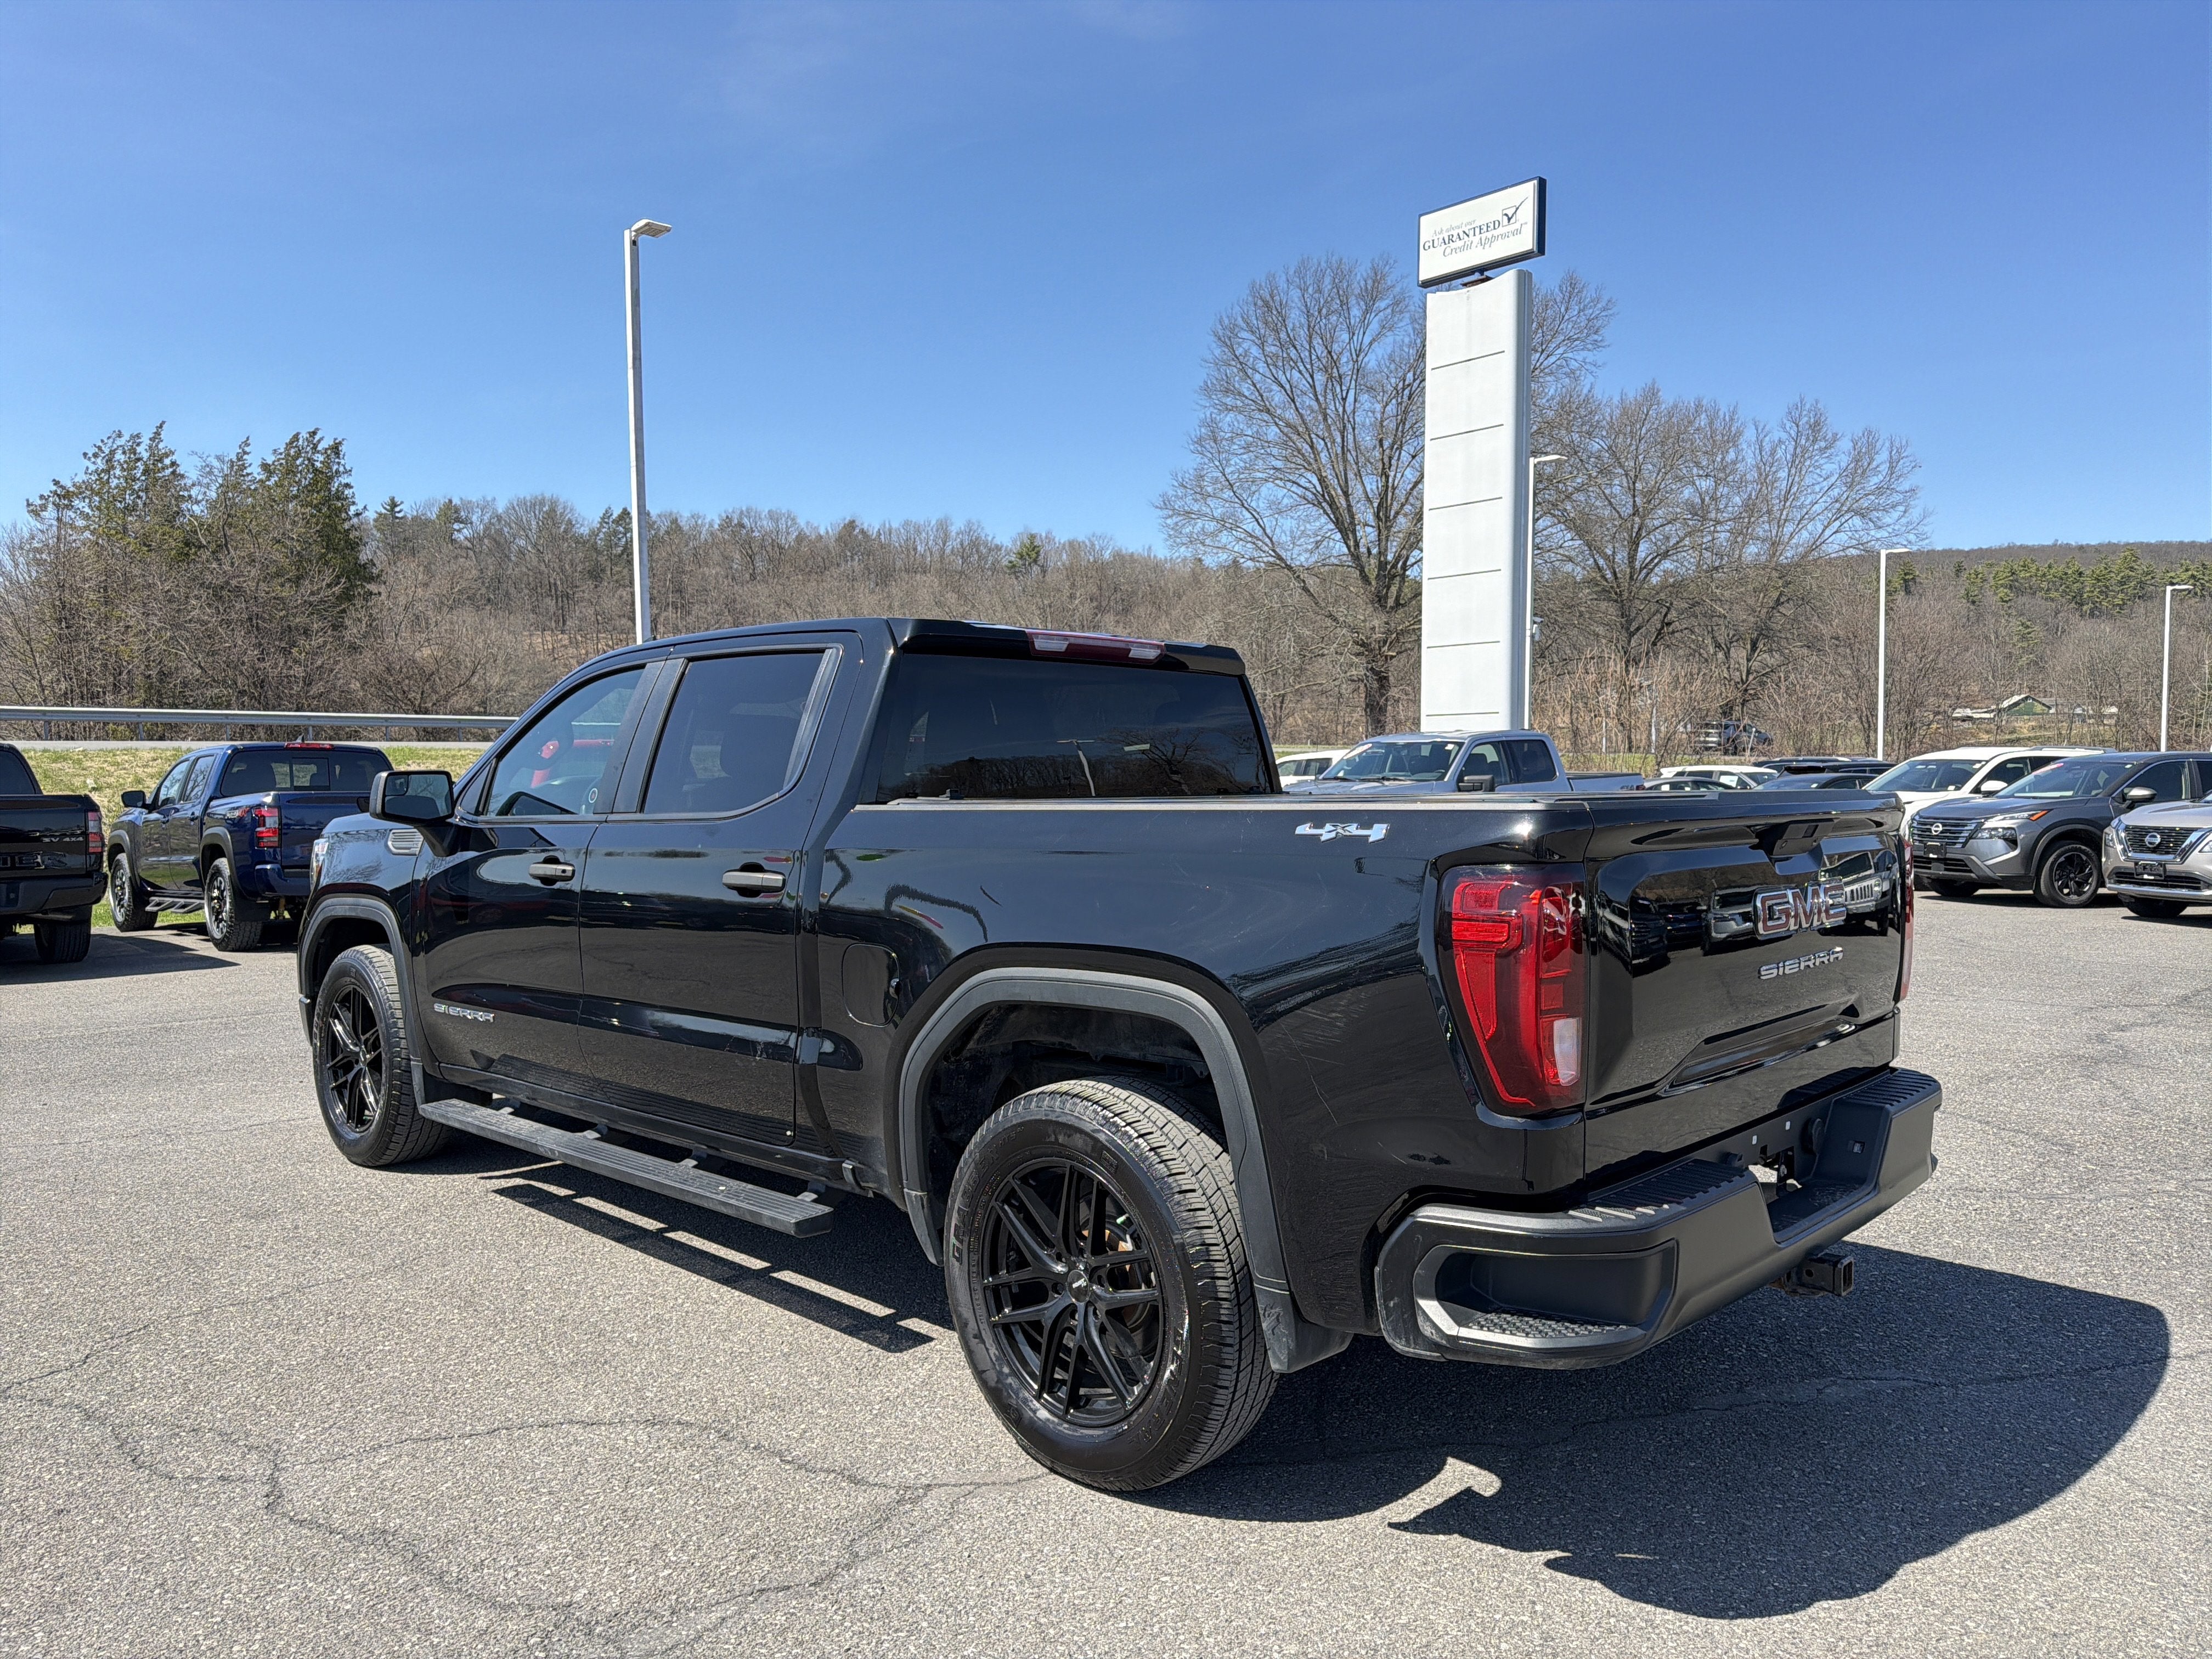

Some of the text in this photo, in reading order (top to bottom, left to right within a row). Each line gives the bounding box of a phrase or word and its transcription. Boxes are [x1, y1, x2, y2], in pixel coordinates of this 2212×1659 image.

[1423, 219, 1500, 251] GUARANTEED
[1443, 223, 1523, 257] Credit Approval
[1445, 222, 1463, 233] about
[1295, 822, 1390, 843] 4X4
[1756, 882, 1847, 935] GMC
[1759, 947, 1844, 980] SIERRA
[433, 1003, 495, 1023] SIERRA
